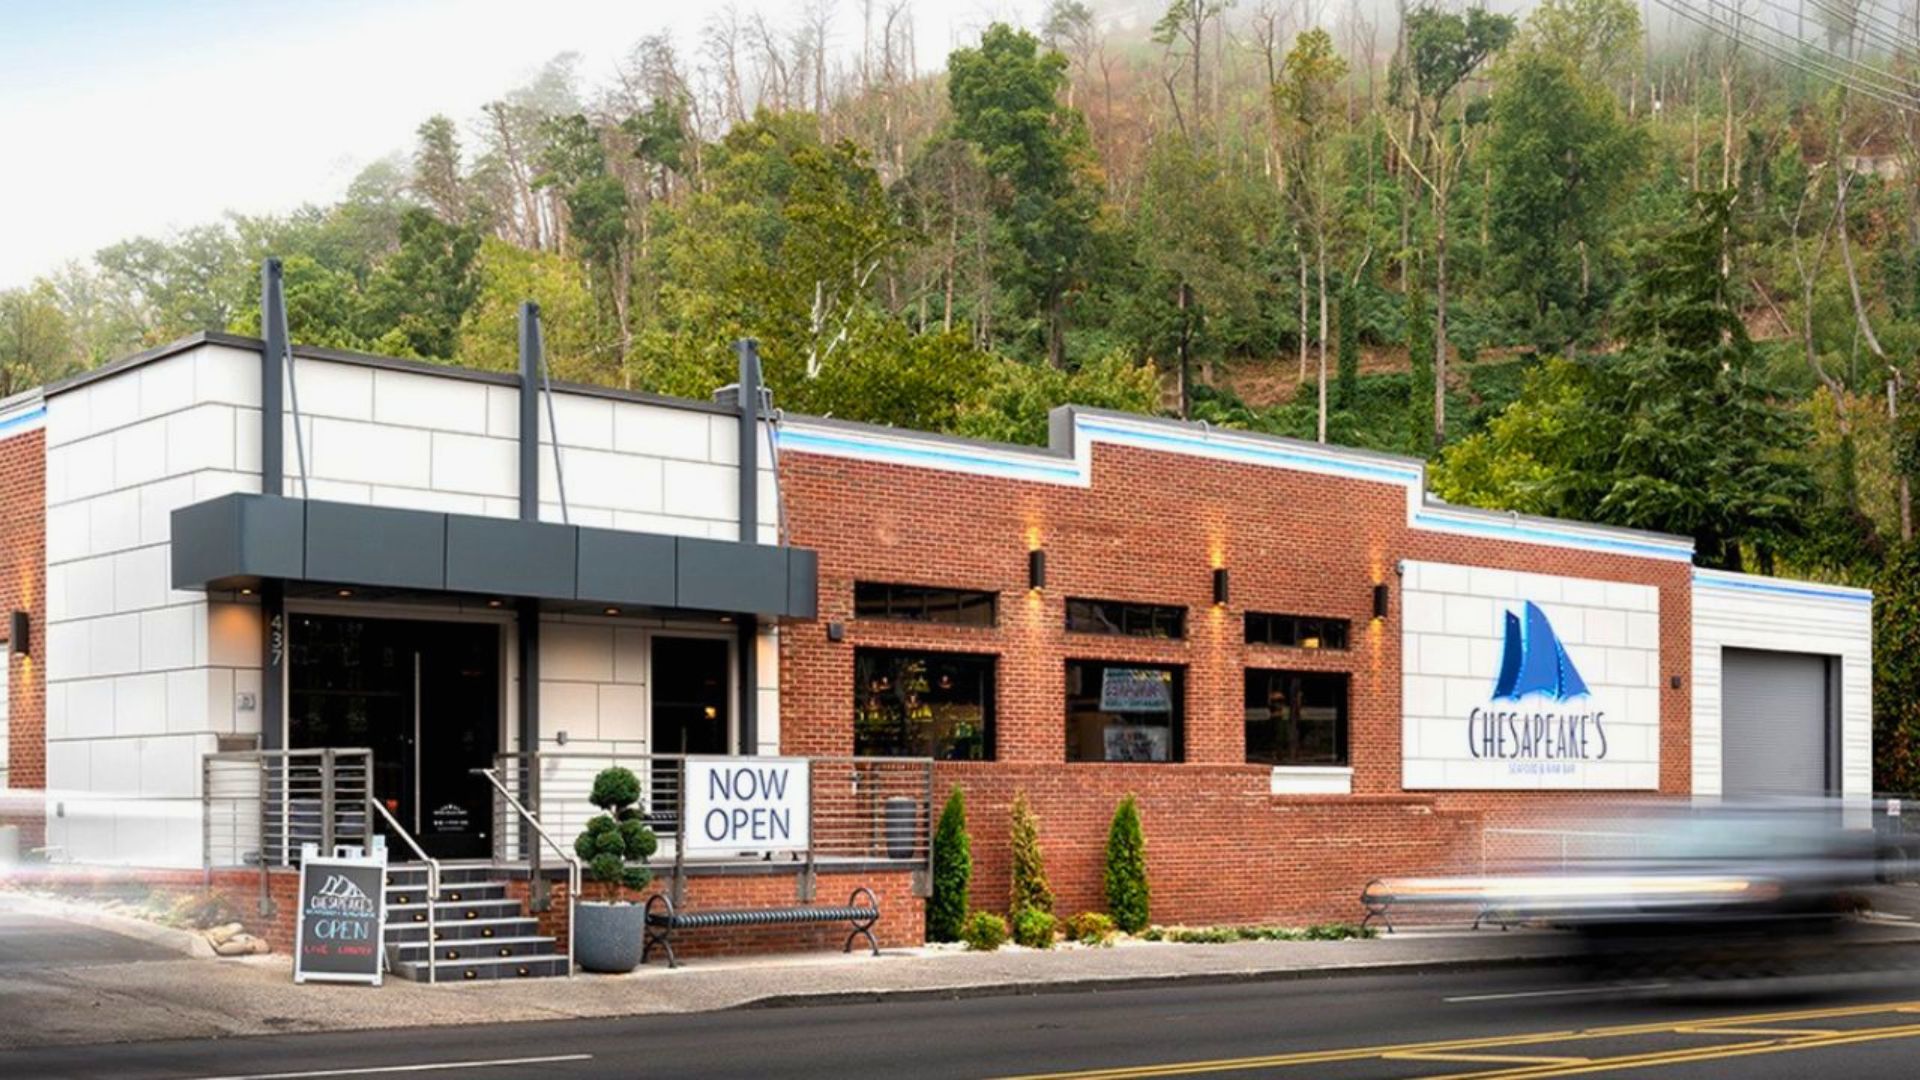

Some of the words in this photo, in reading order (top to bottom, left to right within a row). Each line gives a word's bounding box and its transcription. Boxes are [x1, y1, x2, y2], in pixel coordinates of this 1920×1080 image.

[271, 614, 282, 666] 437
[1468, 707, 1607, 759] CHESAPEAKE'S
[709, 767, 789, 801] NOW
[704, 808, 790, 841] OPEN
[315, 920, 369, 939] OPEN
